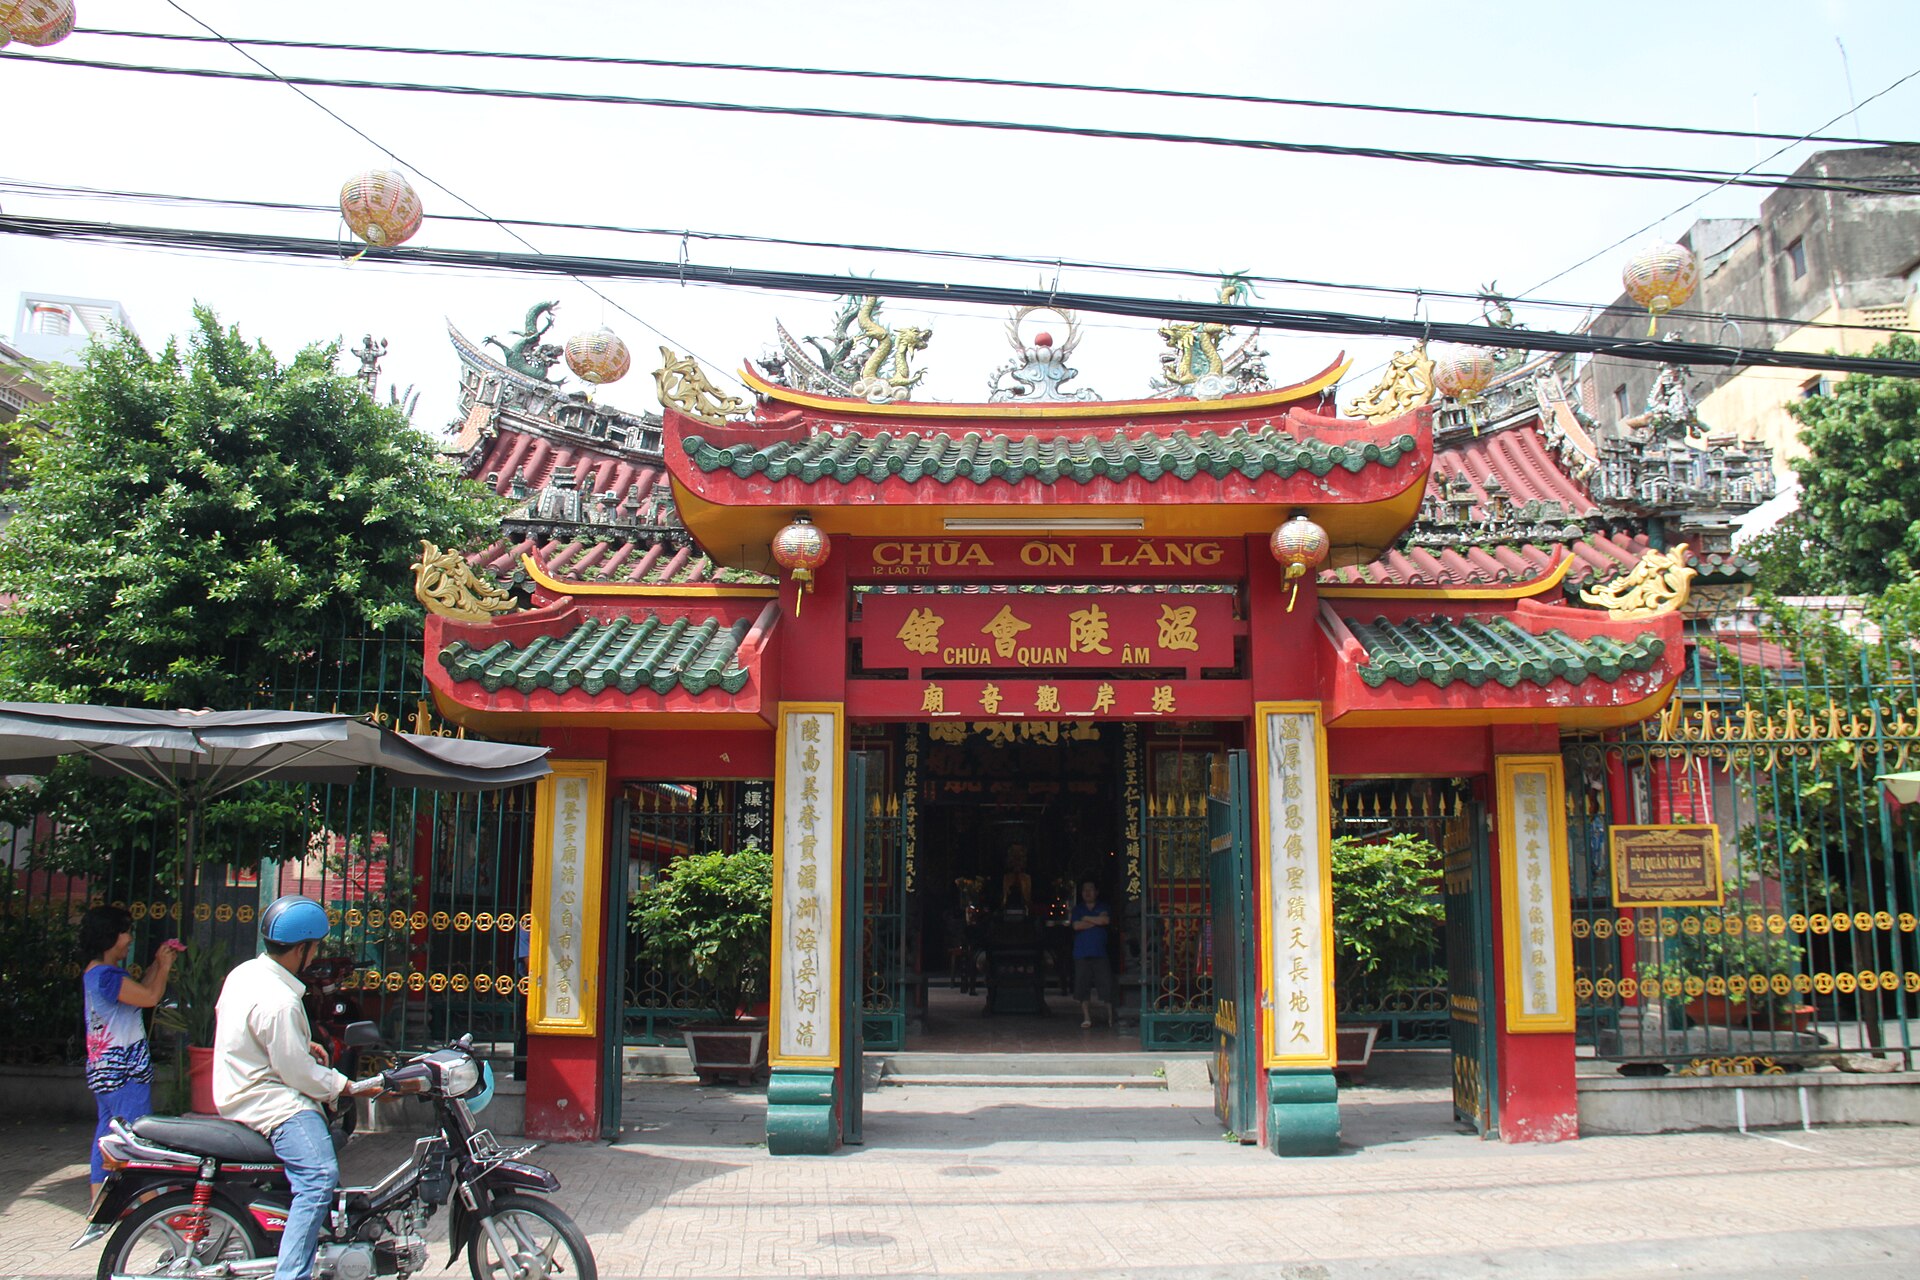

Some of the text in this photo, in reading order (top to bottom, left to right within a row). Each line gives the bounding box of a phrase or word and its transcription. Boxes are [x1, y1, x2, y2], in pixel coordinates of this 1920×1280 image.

[1020, 540, 1077, 566] ÔN
[1100, 538, 1225, 566] LĂNG
[872, 566, 884, 575] 12
[943, 642, 1150, 667] CHÙA QUAN ÂM
